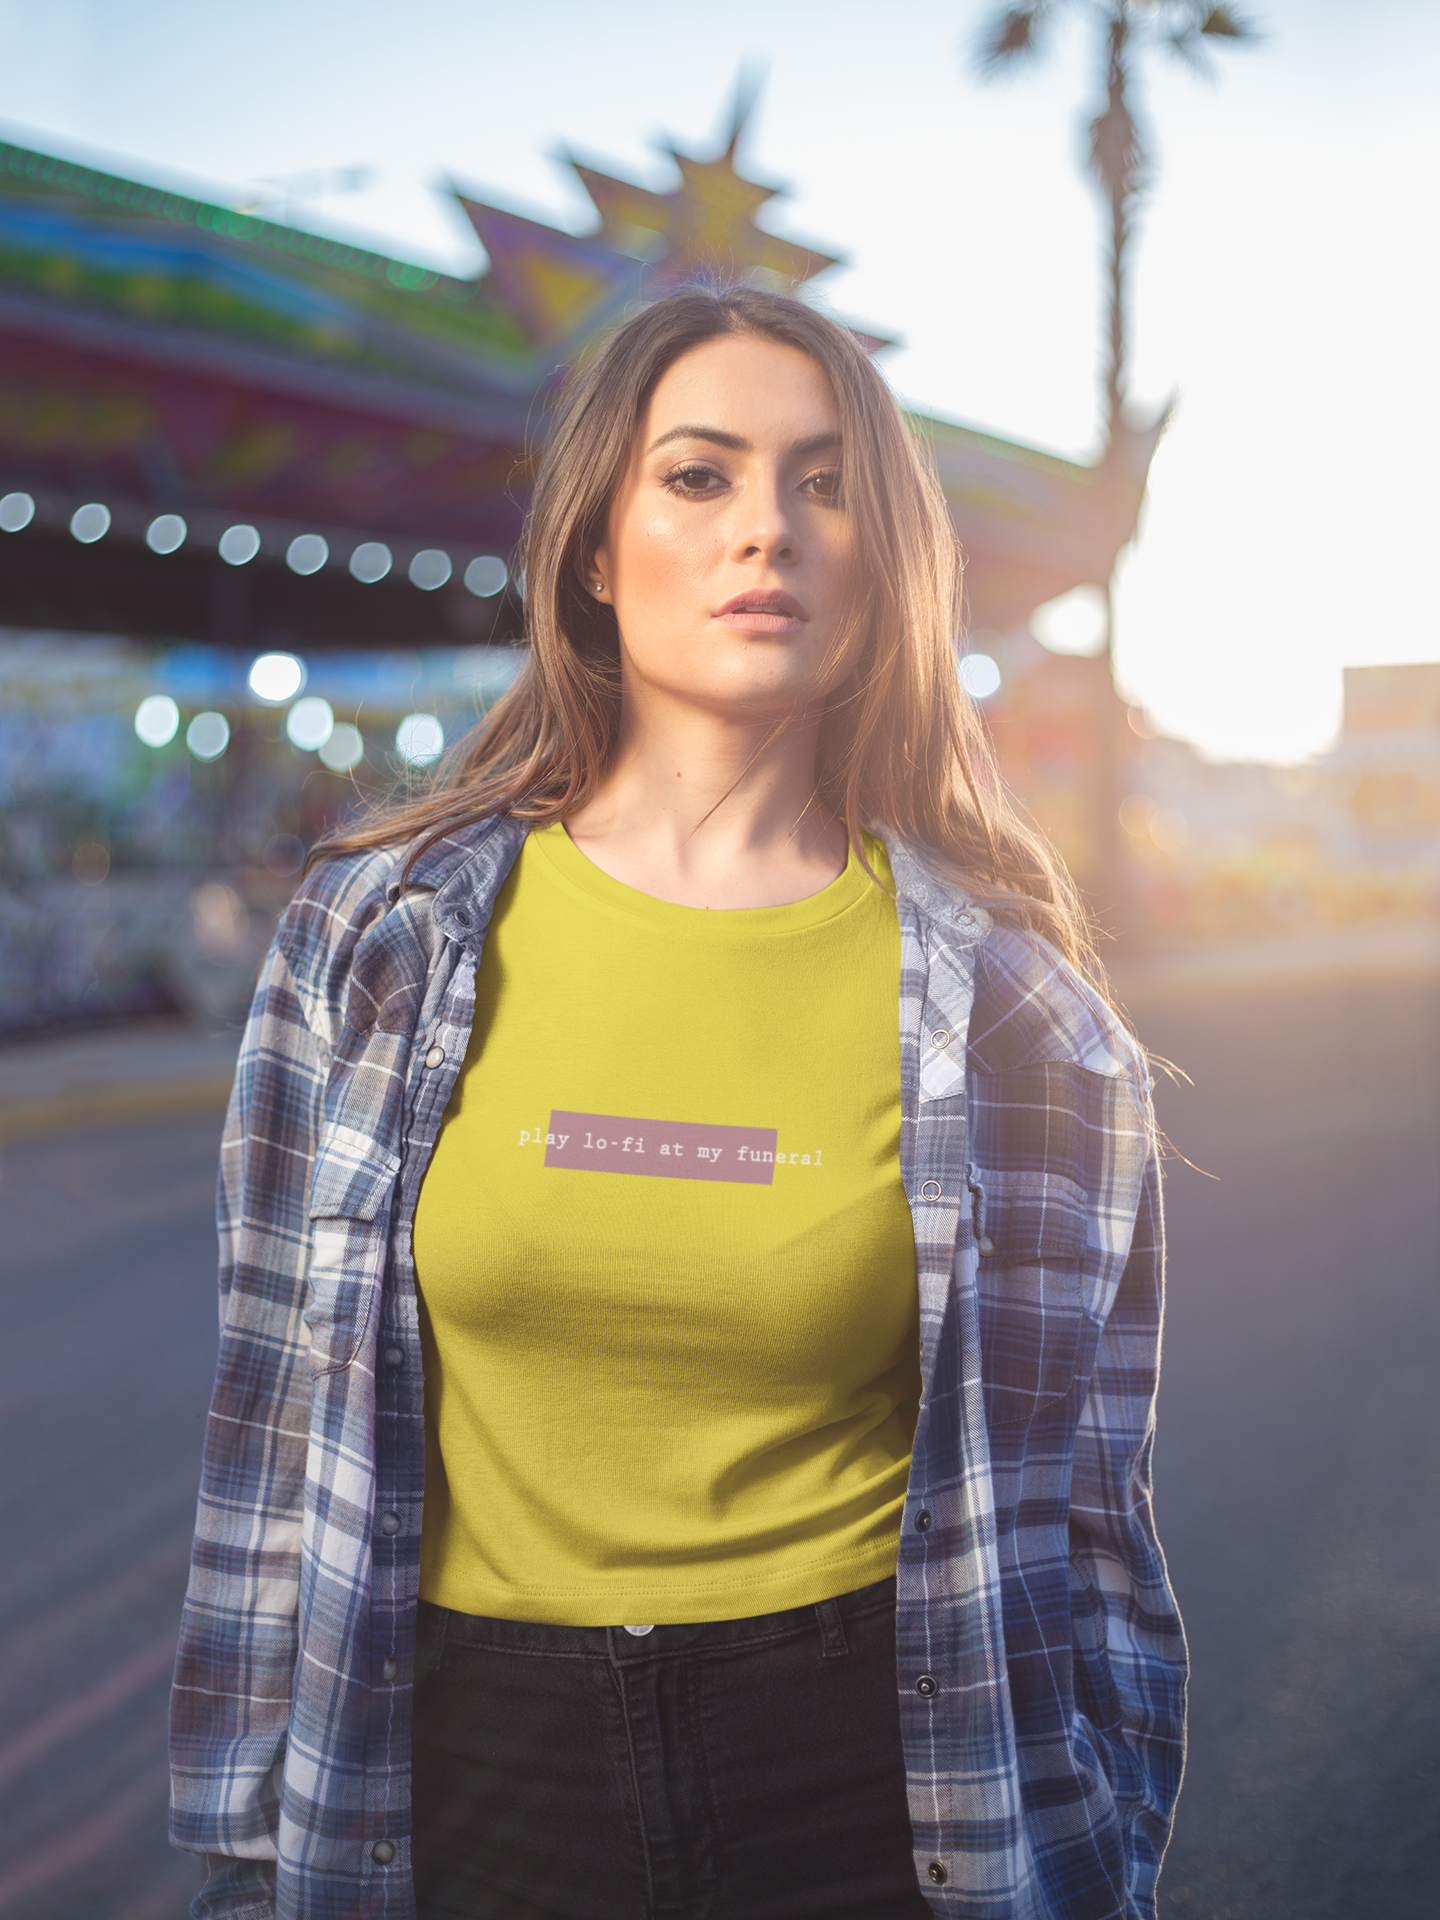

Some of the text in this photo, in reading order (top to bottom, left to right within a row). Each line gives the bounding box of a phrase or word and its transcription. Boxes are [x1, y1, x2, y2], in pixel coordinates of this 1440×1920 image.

[518, 1127, 823, 1166] play lo-fi at my funeral
